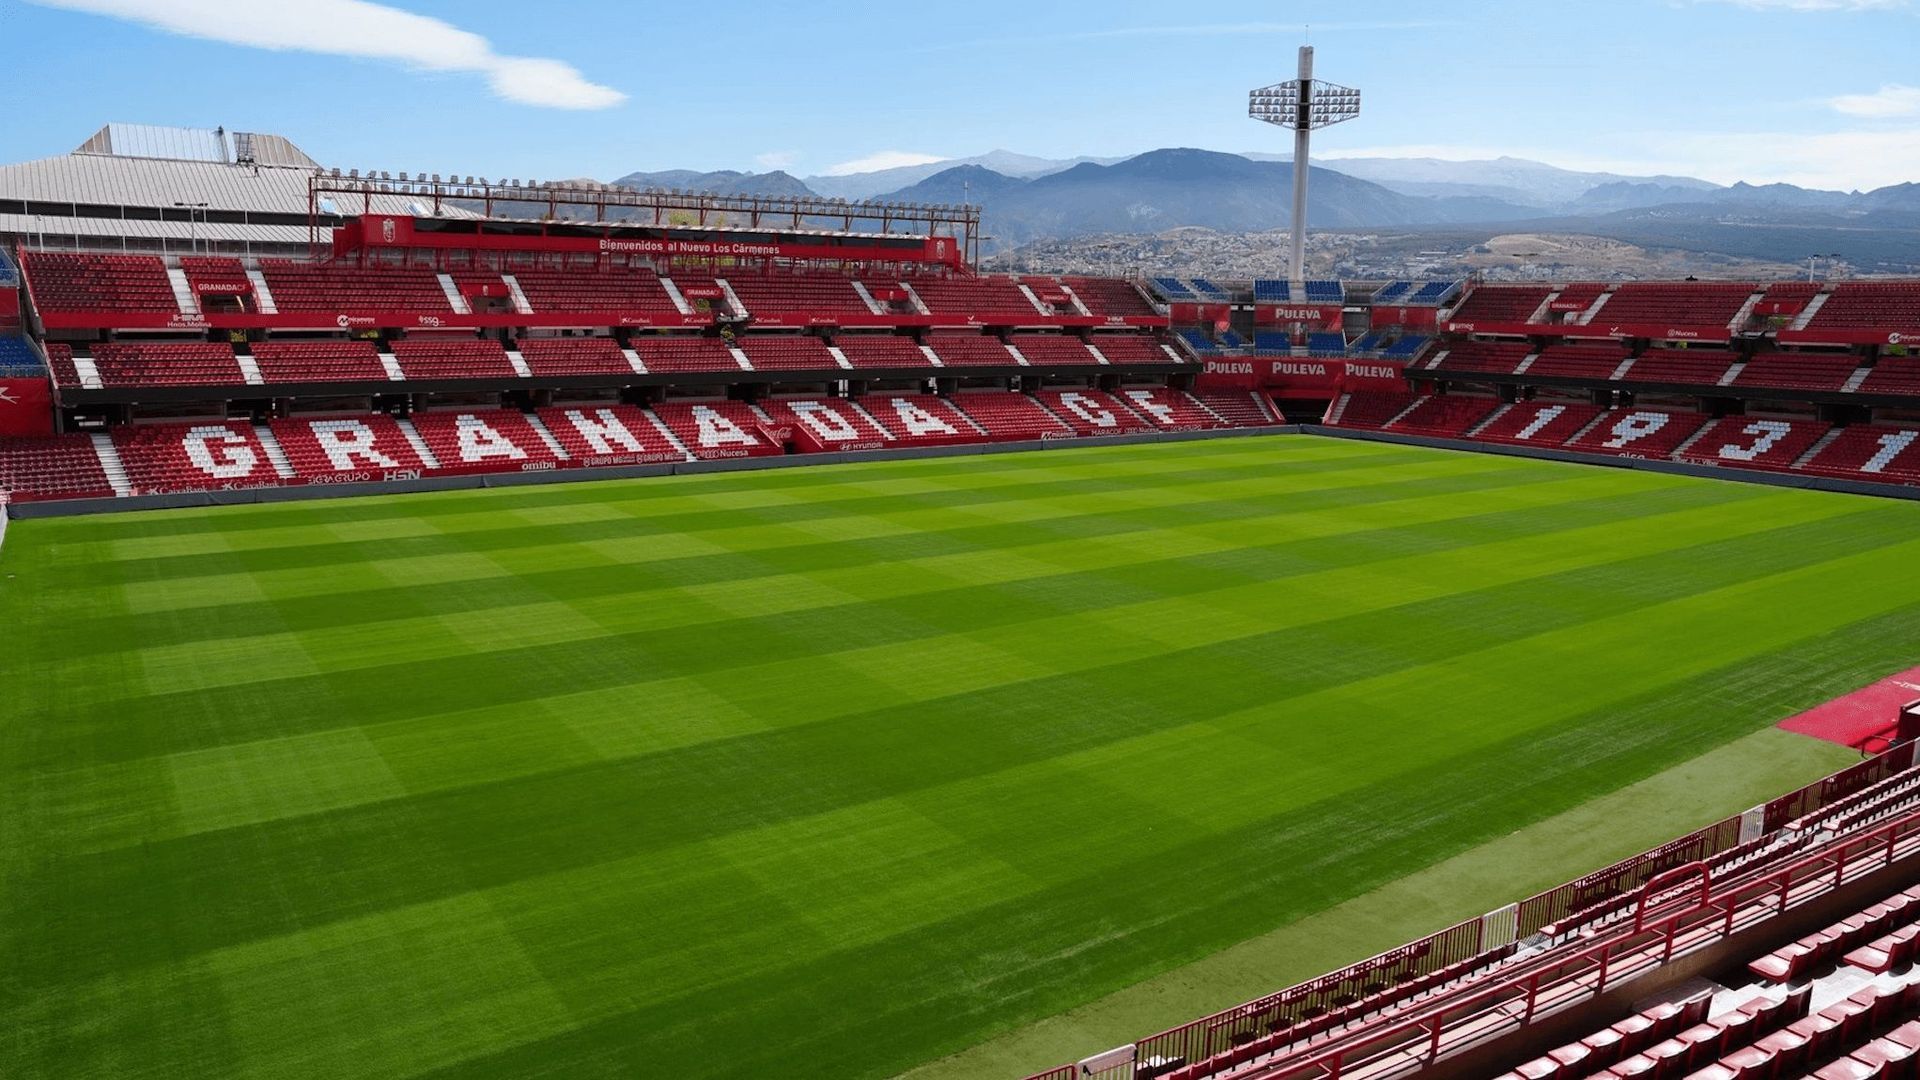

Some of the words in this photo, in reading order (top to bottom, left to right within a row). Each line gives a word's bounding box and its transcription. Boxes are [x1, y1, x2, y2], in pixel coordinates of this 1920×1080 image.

[599, 239, 663, 251] Bienvenidos
[667, 241, 677, 251] al
[679, 242, 711, 252] Nuevo
[713, 243, 730, 253] Los
[732, 243, 780, 254] Cármenes
[1275, 308, 1321, 319] PULEVA
[1207, 361, 1253, 374] PULEVA
[1272, 361, 1326, 375] PULEVA
[1345, 363, 1395, 378] PULEVA
[182, 397, 959, 478] GRANADA
[1514, 405, 1920, 472] 1931
[853, 442, 884, 450] HYUNDAI
[521, 460, 556, 470] omibu
[384, 469, 420, 482] HSN
[234, 480, 280, 490] CaixaBank
